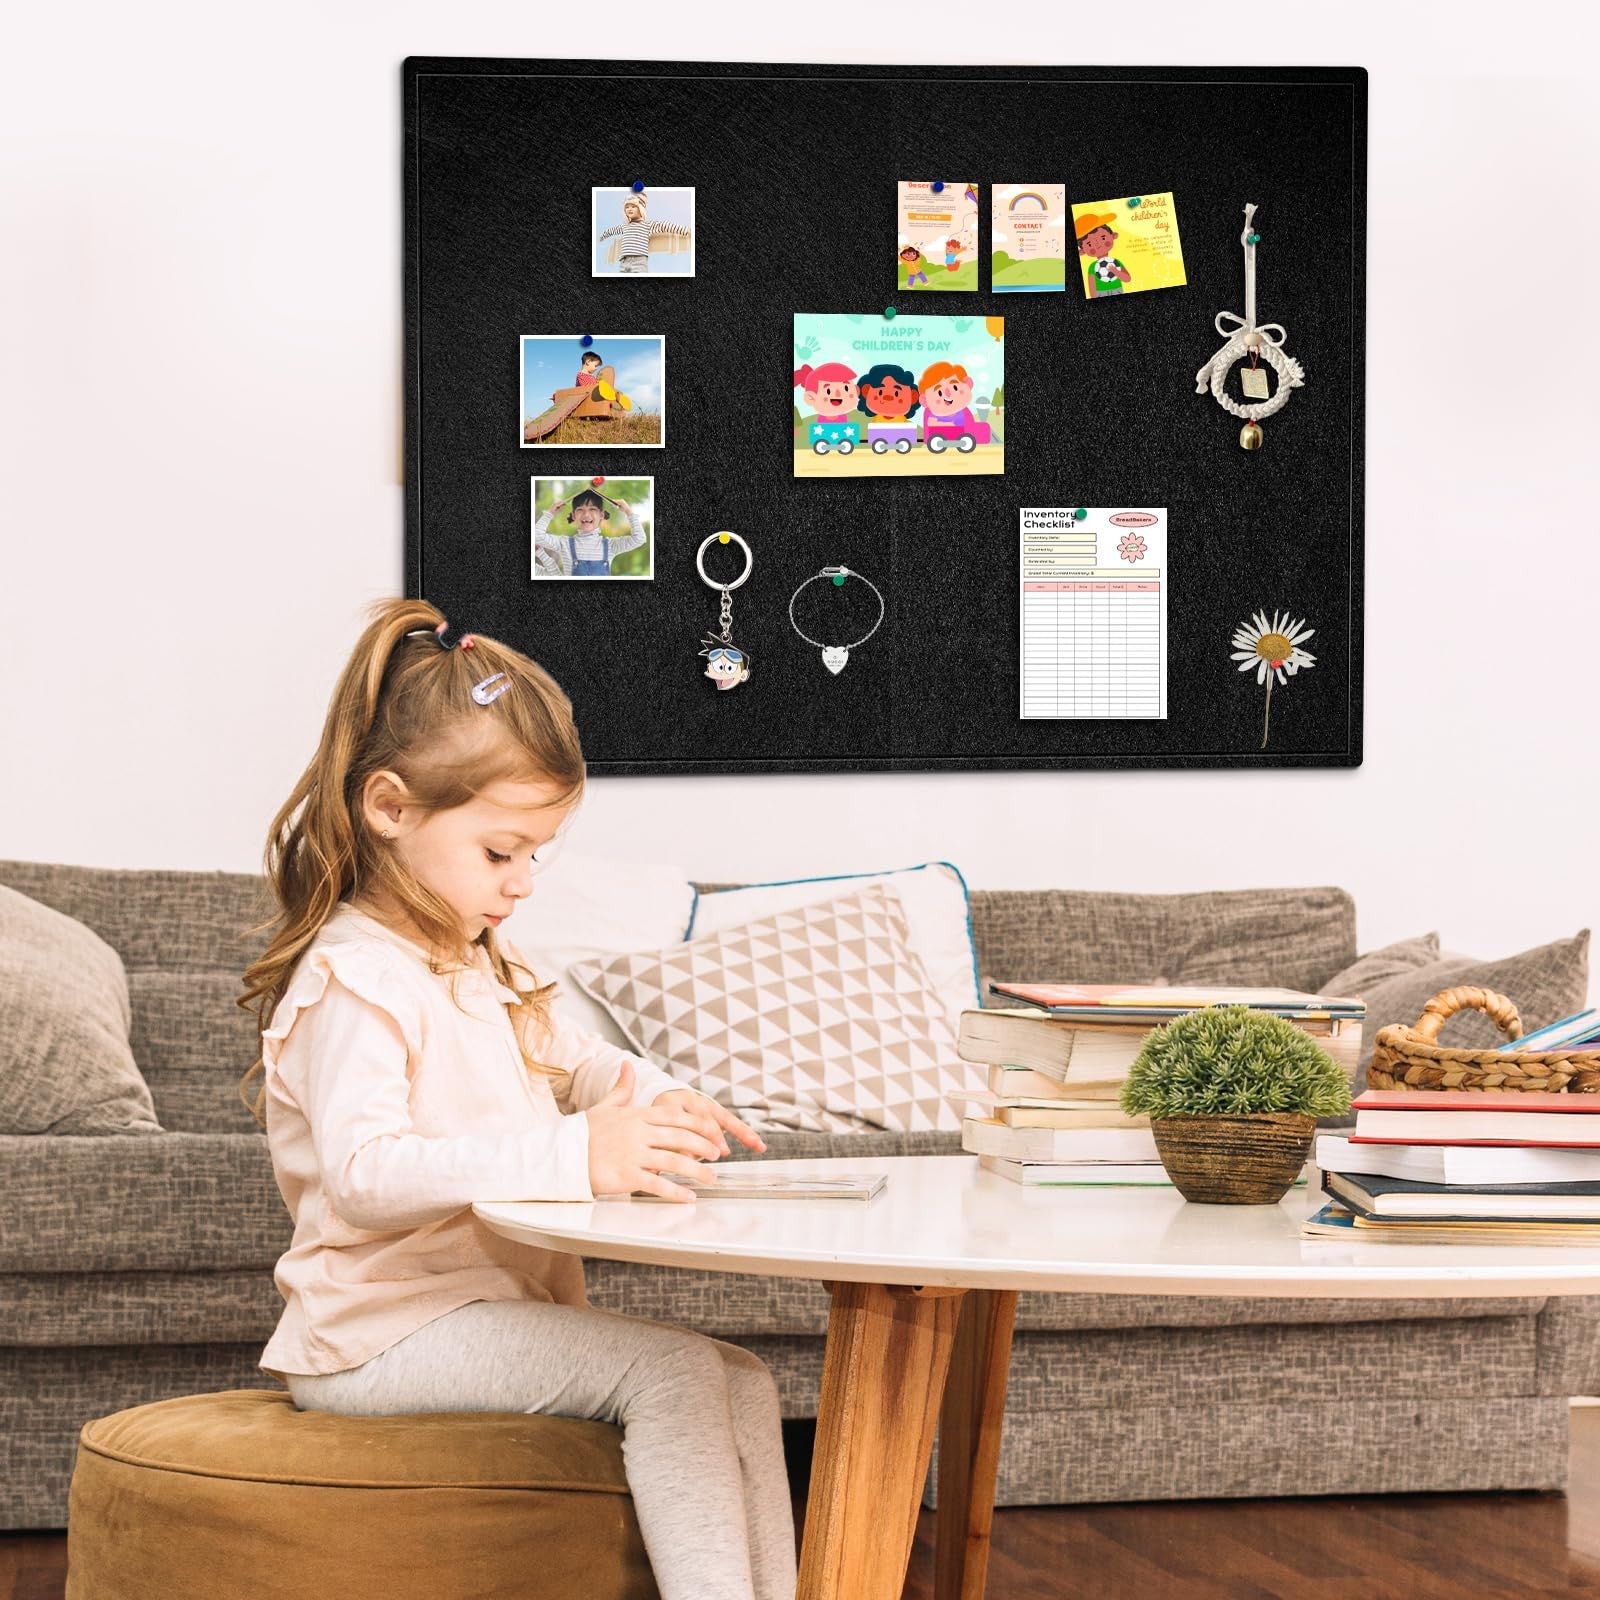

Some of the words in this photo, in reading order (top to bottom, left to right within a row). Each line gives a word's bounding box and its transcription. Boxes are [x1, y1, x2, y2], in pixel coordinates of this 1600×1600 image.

[1155, 220, 1169, 232] day
[881, 327, 923, 337] HAPPY
[927, 341, 951, 351] DAY
[1024, 510, 1077, 520] Inventory
[1024, 520, 1075, 528] Checklist
